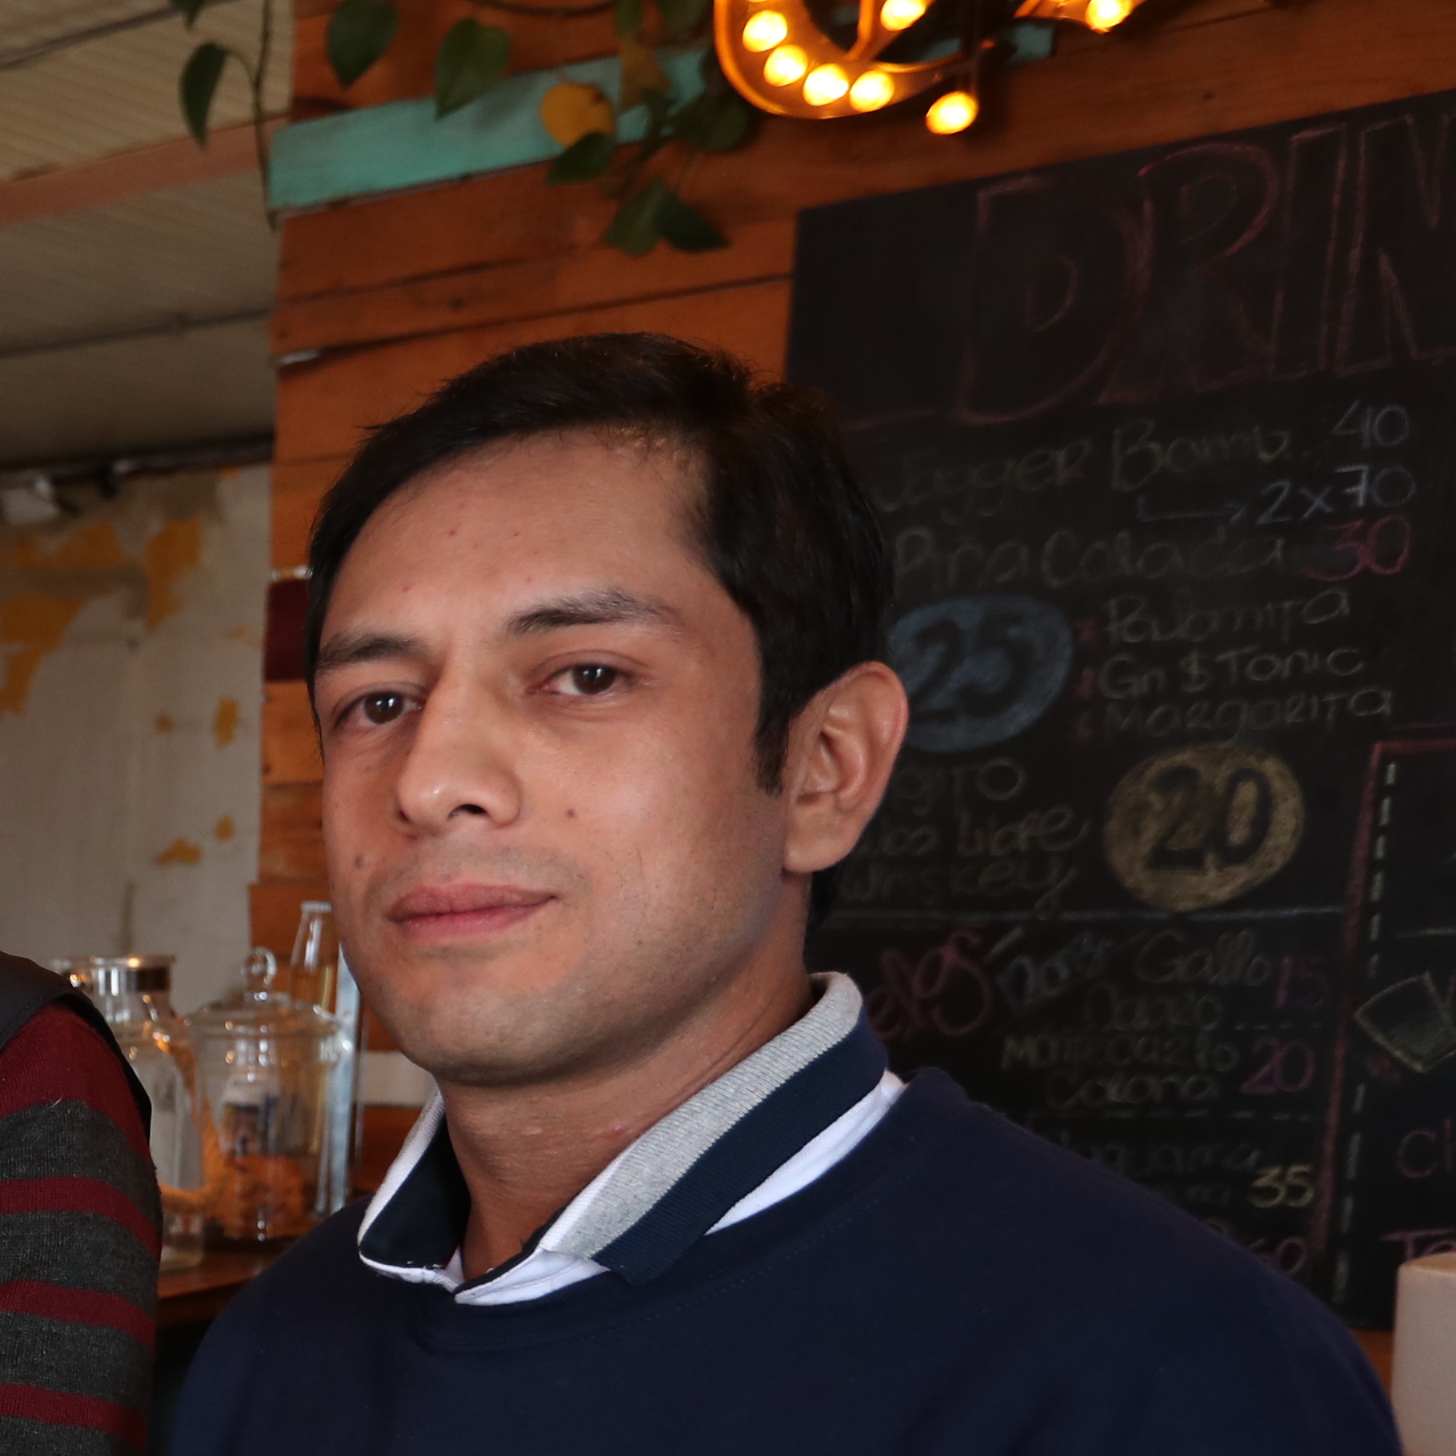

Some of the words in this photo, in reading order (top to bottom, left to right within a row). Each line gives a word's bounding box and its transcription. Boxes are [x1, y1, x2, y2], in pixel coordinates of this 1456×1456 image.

[1332, 398, 1411, 450] 40
[1302, 514, 1414, 584] 30
[1143, 765, 1274, 873] 20
[1240, 1035, 1317, 1095] 20
[1247, 1164, 1317, 1209] 35
